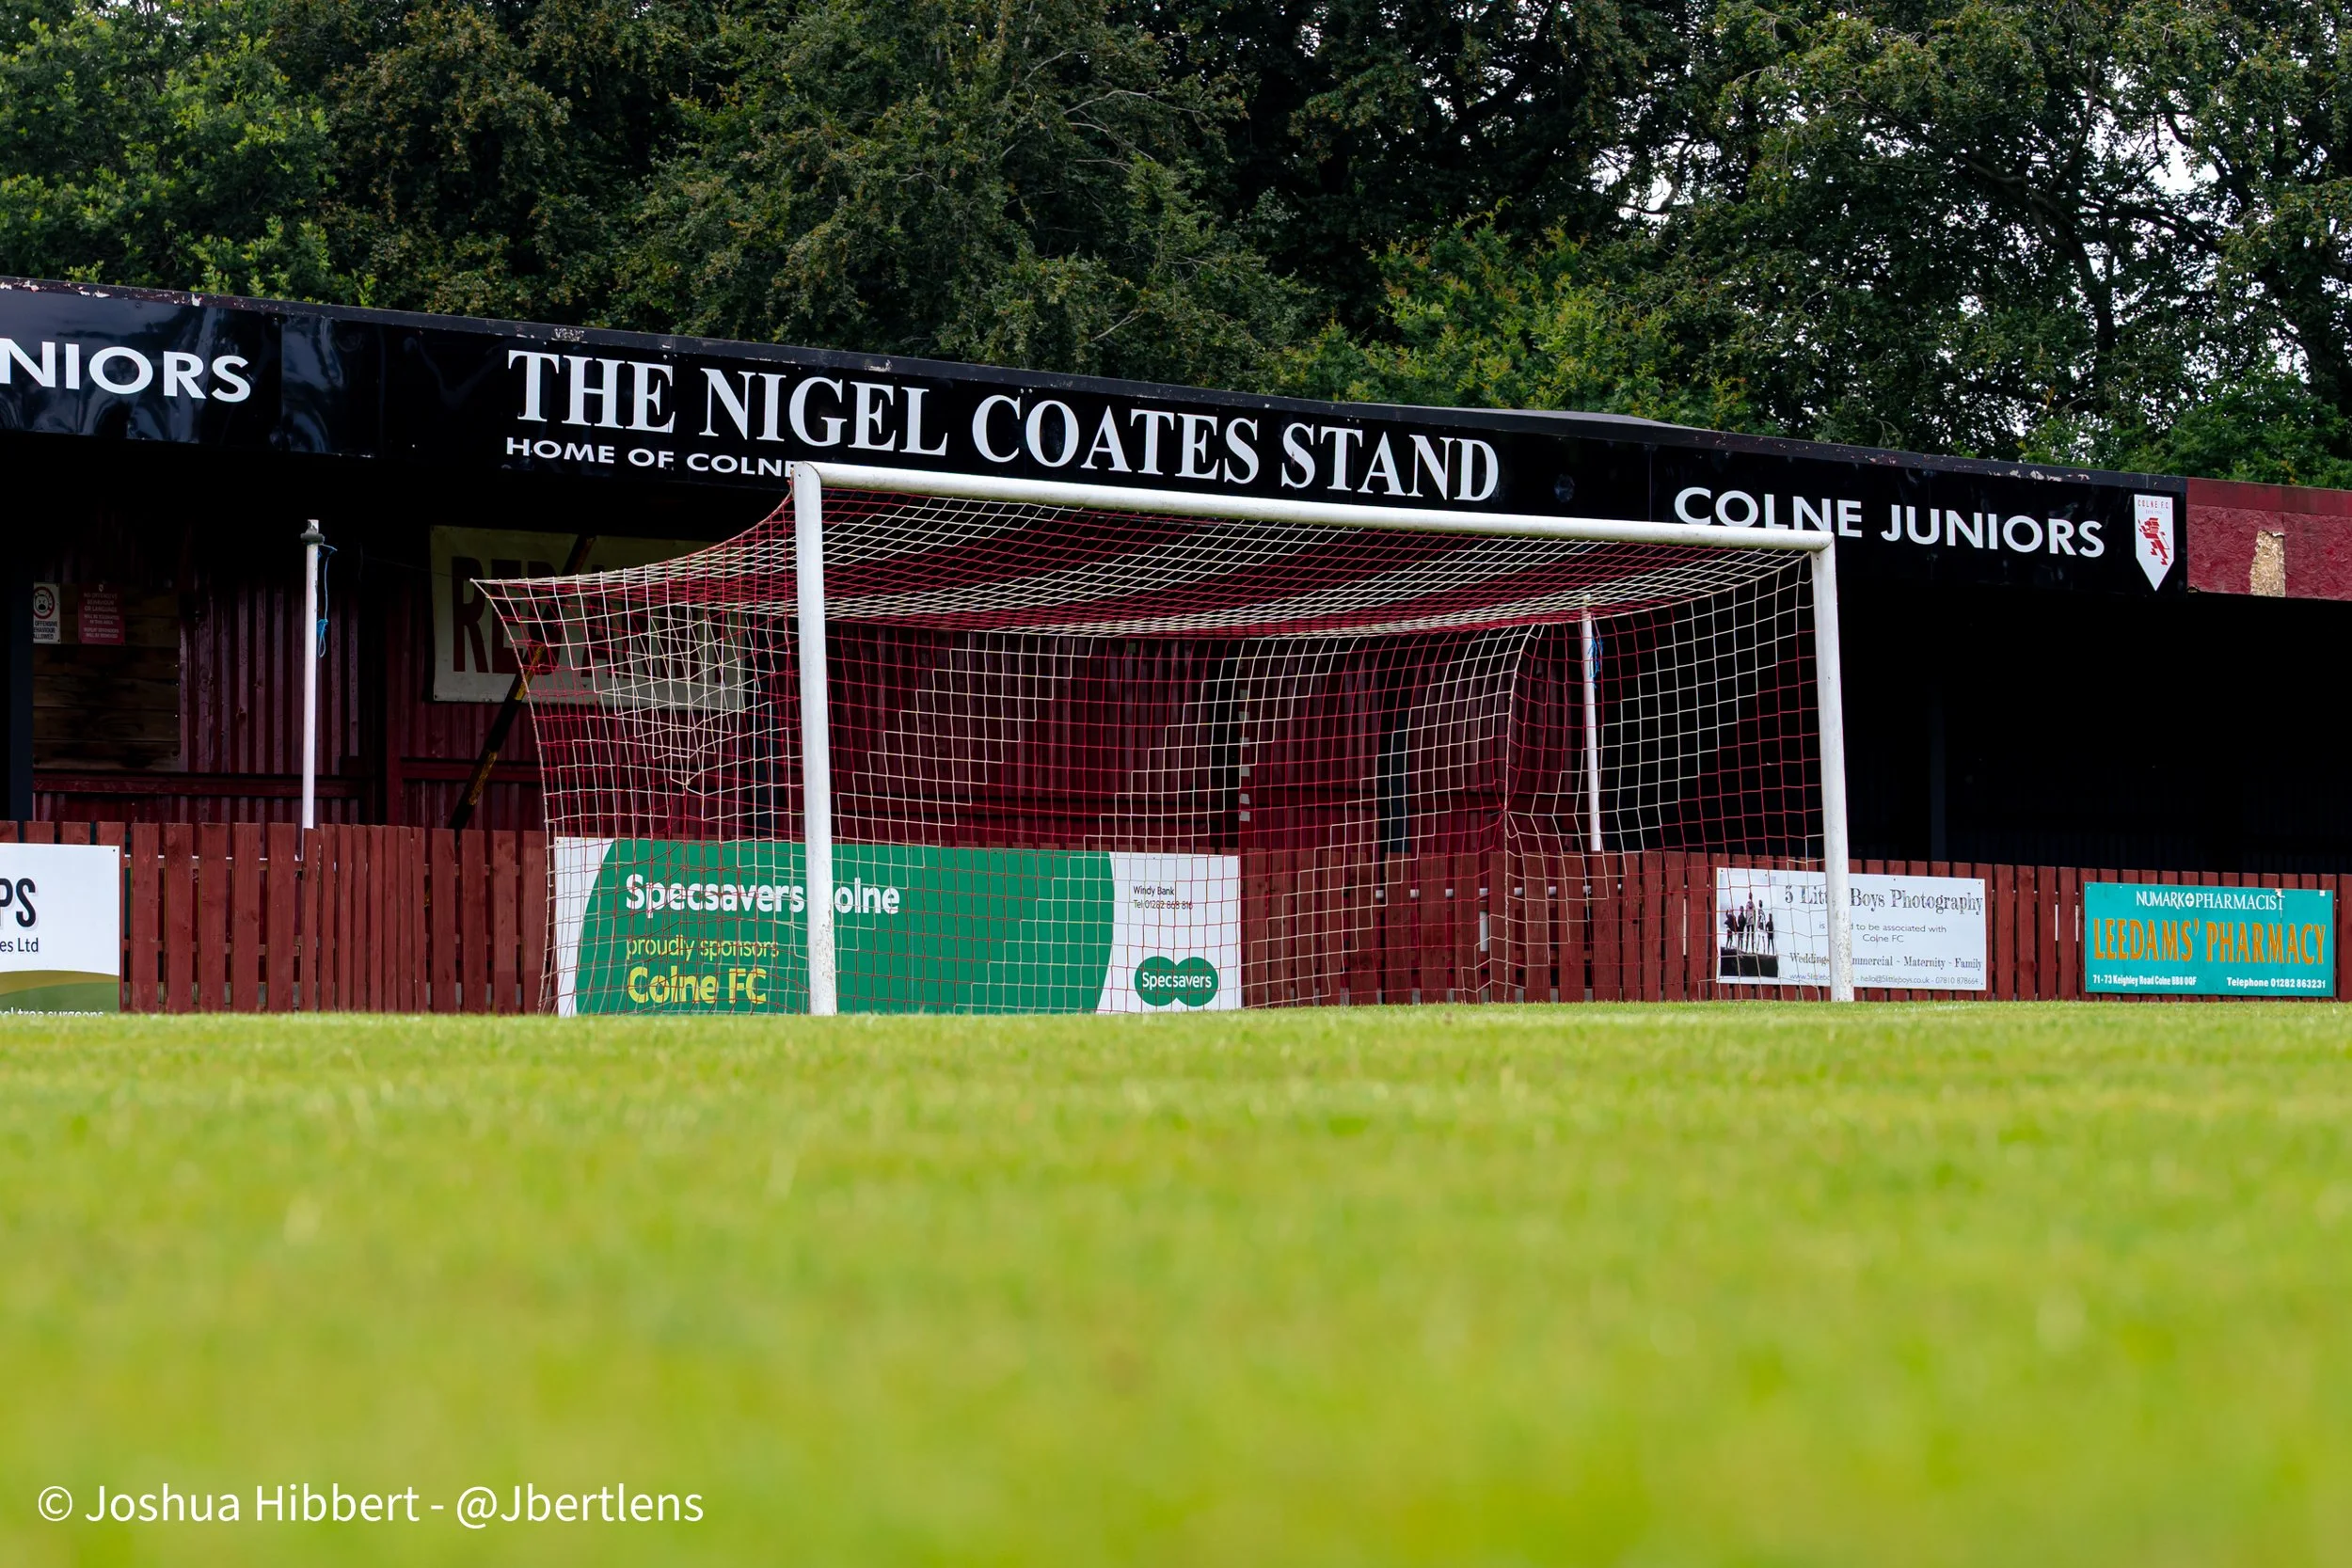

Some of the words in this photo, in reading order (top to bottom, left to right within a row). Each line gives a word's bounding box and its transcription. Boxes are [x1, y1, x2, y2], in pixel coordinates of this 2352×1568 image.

[508, 349, 675, 434] THE
[699, 368, 948, 456] NIGEL
[972, 394, 1260, 484] COATES
[1280, 422, 1499, 501] STAND
[506, 437, 615, 464] HOME
[628, 448, 675, 468] OF
[2137, 499, 2158, 509] COLNE
[1674, 486, 1863, 538] COLNE
[1880, 504, 2106, 558] JUNIORS
[452, 556, 563, 674] RED
[626, 873, 805, 919] Specsavers
[834, 877, 900, 915] olne
[1133, 885, 1155, 897] Windy
[1157, 886, 1175, 895] Bank
[1784, 885, 1794, 904] 5
[1850, 887, 1885, 912] Boys
[1889, 888, 1983, 916] Photography
[2136, 890, 2185, 911] NUMARK
[2195, 892, 2285, 911] PHARMACIST
[1863, 933, 1889, 943] Colne
[1891, 934, 1905, 943] FC
[1867, 923, 1881, 931] be
[1883, 925, 1926, 933] associated
[1929, 925, 1947, 934] with
[17, 937, 39, 953] Ltd
[626, 935, 696, 960] proudly
[700, 939, 780, 960] sponsors
[2093, 918, 2200, 963] LEEDAMS'
[2205, 921, 2327, 965] PHARMACY
[1903, 956, 1947, 971] Maternity
[1954, 957, 1982, 971] Family
[628, 965, 720, 1004] Colne
[728, 968, 767, 1005] FC
[1141, 972, 1213, 990] Specsavers
[2112, 974, 2138, 987] Keighley
[2138, 975, 2154, 985] Road
[2226, 976, 2269, 990] Telephone
[2270, 977, 2296, 988] 01282
